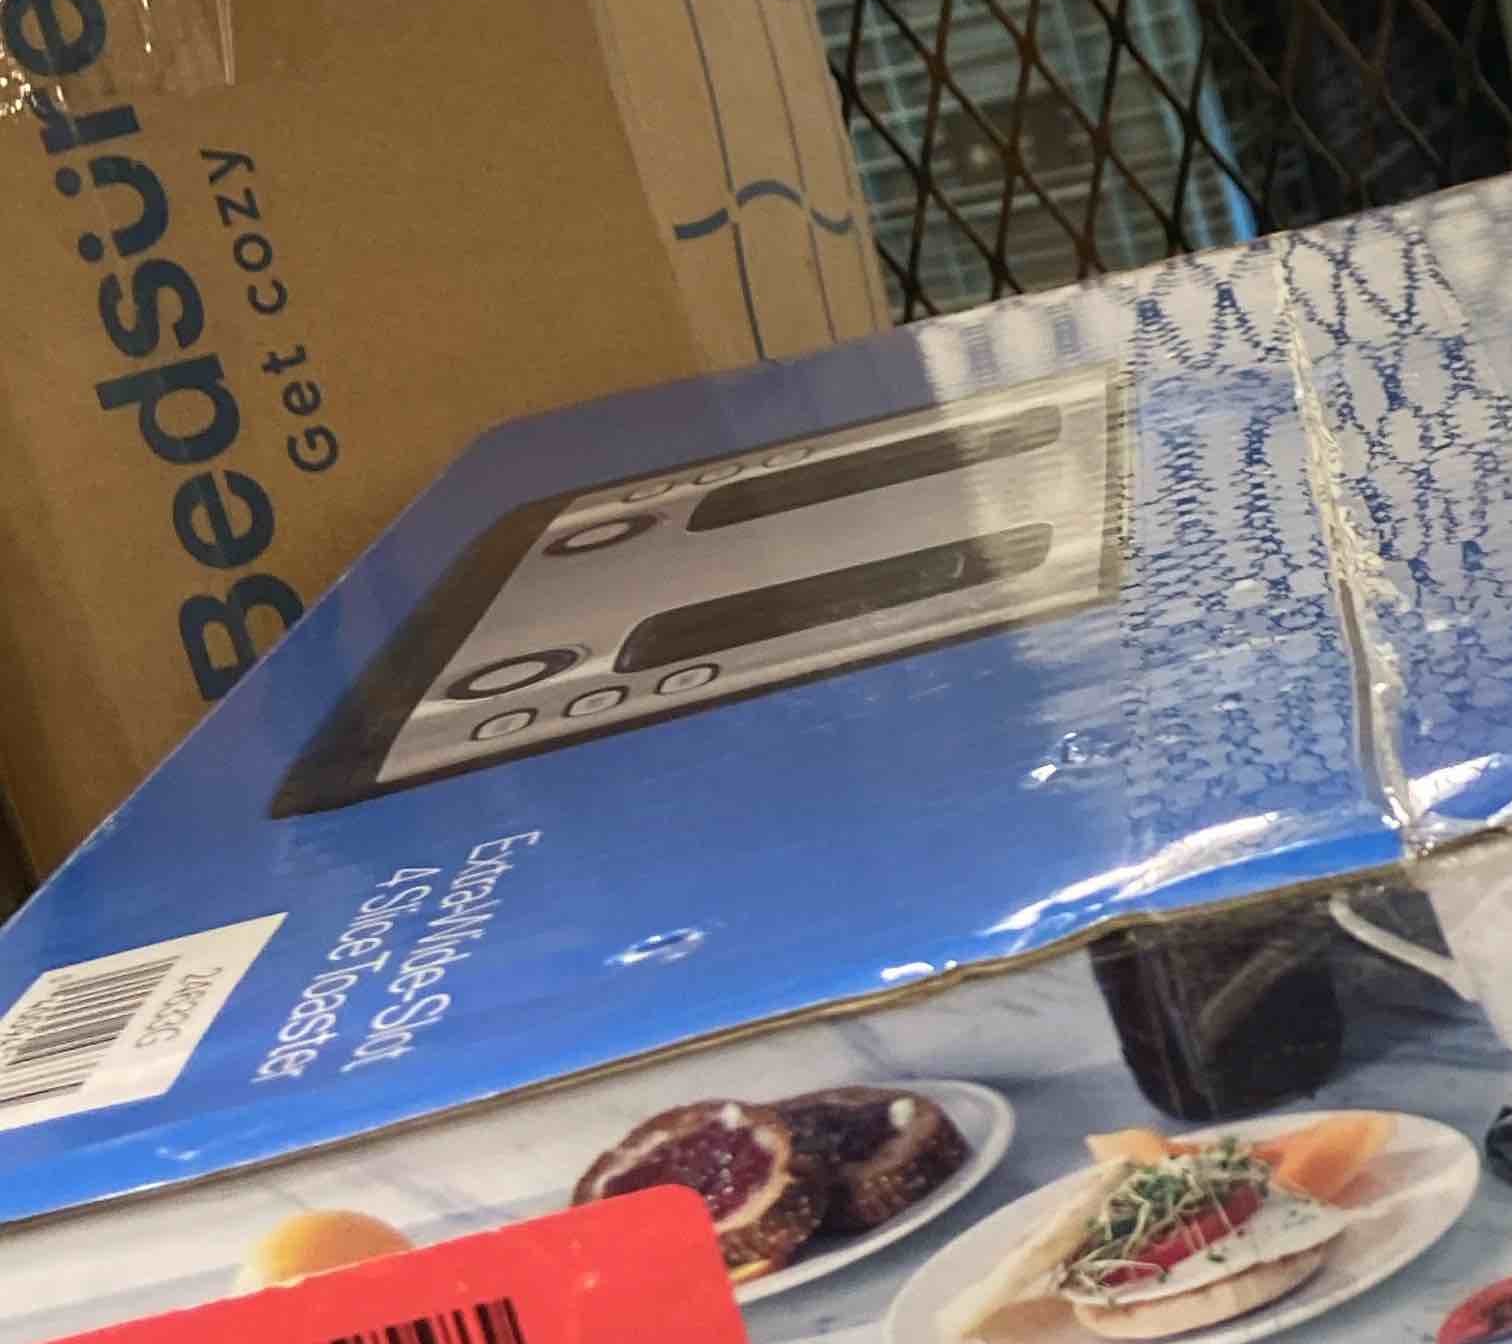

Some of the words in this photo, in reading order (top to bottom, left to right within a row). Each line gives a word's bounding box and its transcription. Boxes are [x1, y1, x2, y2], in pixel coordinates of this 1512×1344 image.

[199, 146, 290, 316] cozy
[262, 343, 341, 474] Get
[327, 885, 432, 960] Slice
[376, 867, 442, 888] 4
[251, 950, 392, 1083] Toaster
